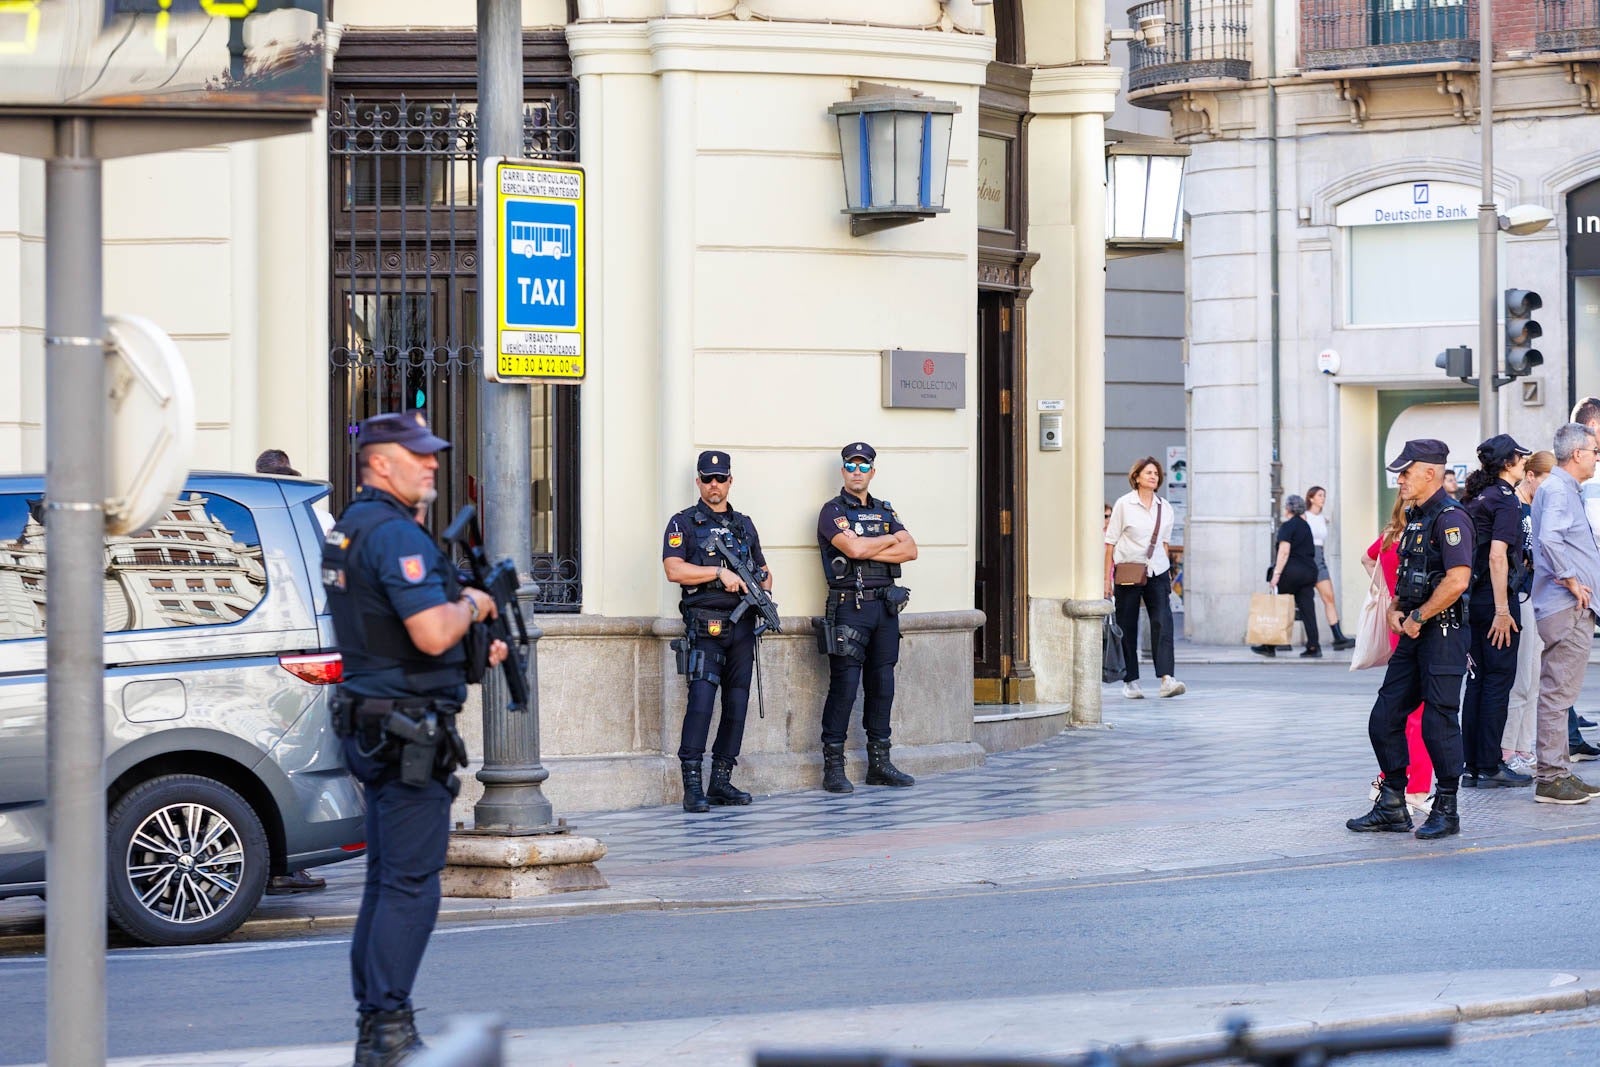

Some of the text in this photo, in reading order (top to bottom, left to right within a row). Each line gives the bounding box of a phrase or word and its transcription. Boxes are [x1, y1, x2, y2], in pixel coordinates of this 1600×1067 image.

[503, 170, 525, 182] CARRIL
[527, 173, 535, 182] DE
[503, 183, 579, 198] ESPECIALMENTE PROTEGIDO
[1375, 204, 1468, 222] Deutsche Bank
[517, 277, 566, 306] TAXI
[525, 333, 559, 343] URBANOS Y
[538, 345, 576, 355] AUTORIZADOS
[501, 357, 512, 371] DE
[538, 358, 543, 372] A
[911, 380, 958, 391] COLLECTION
